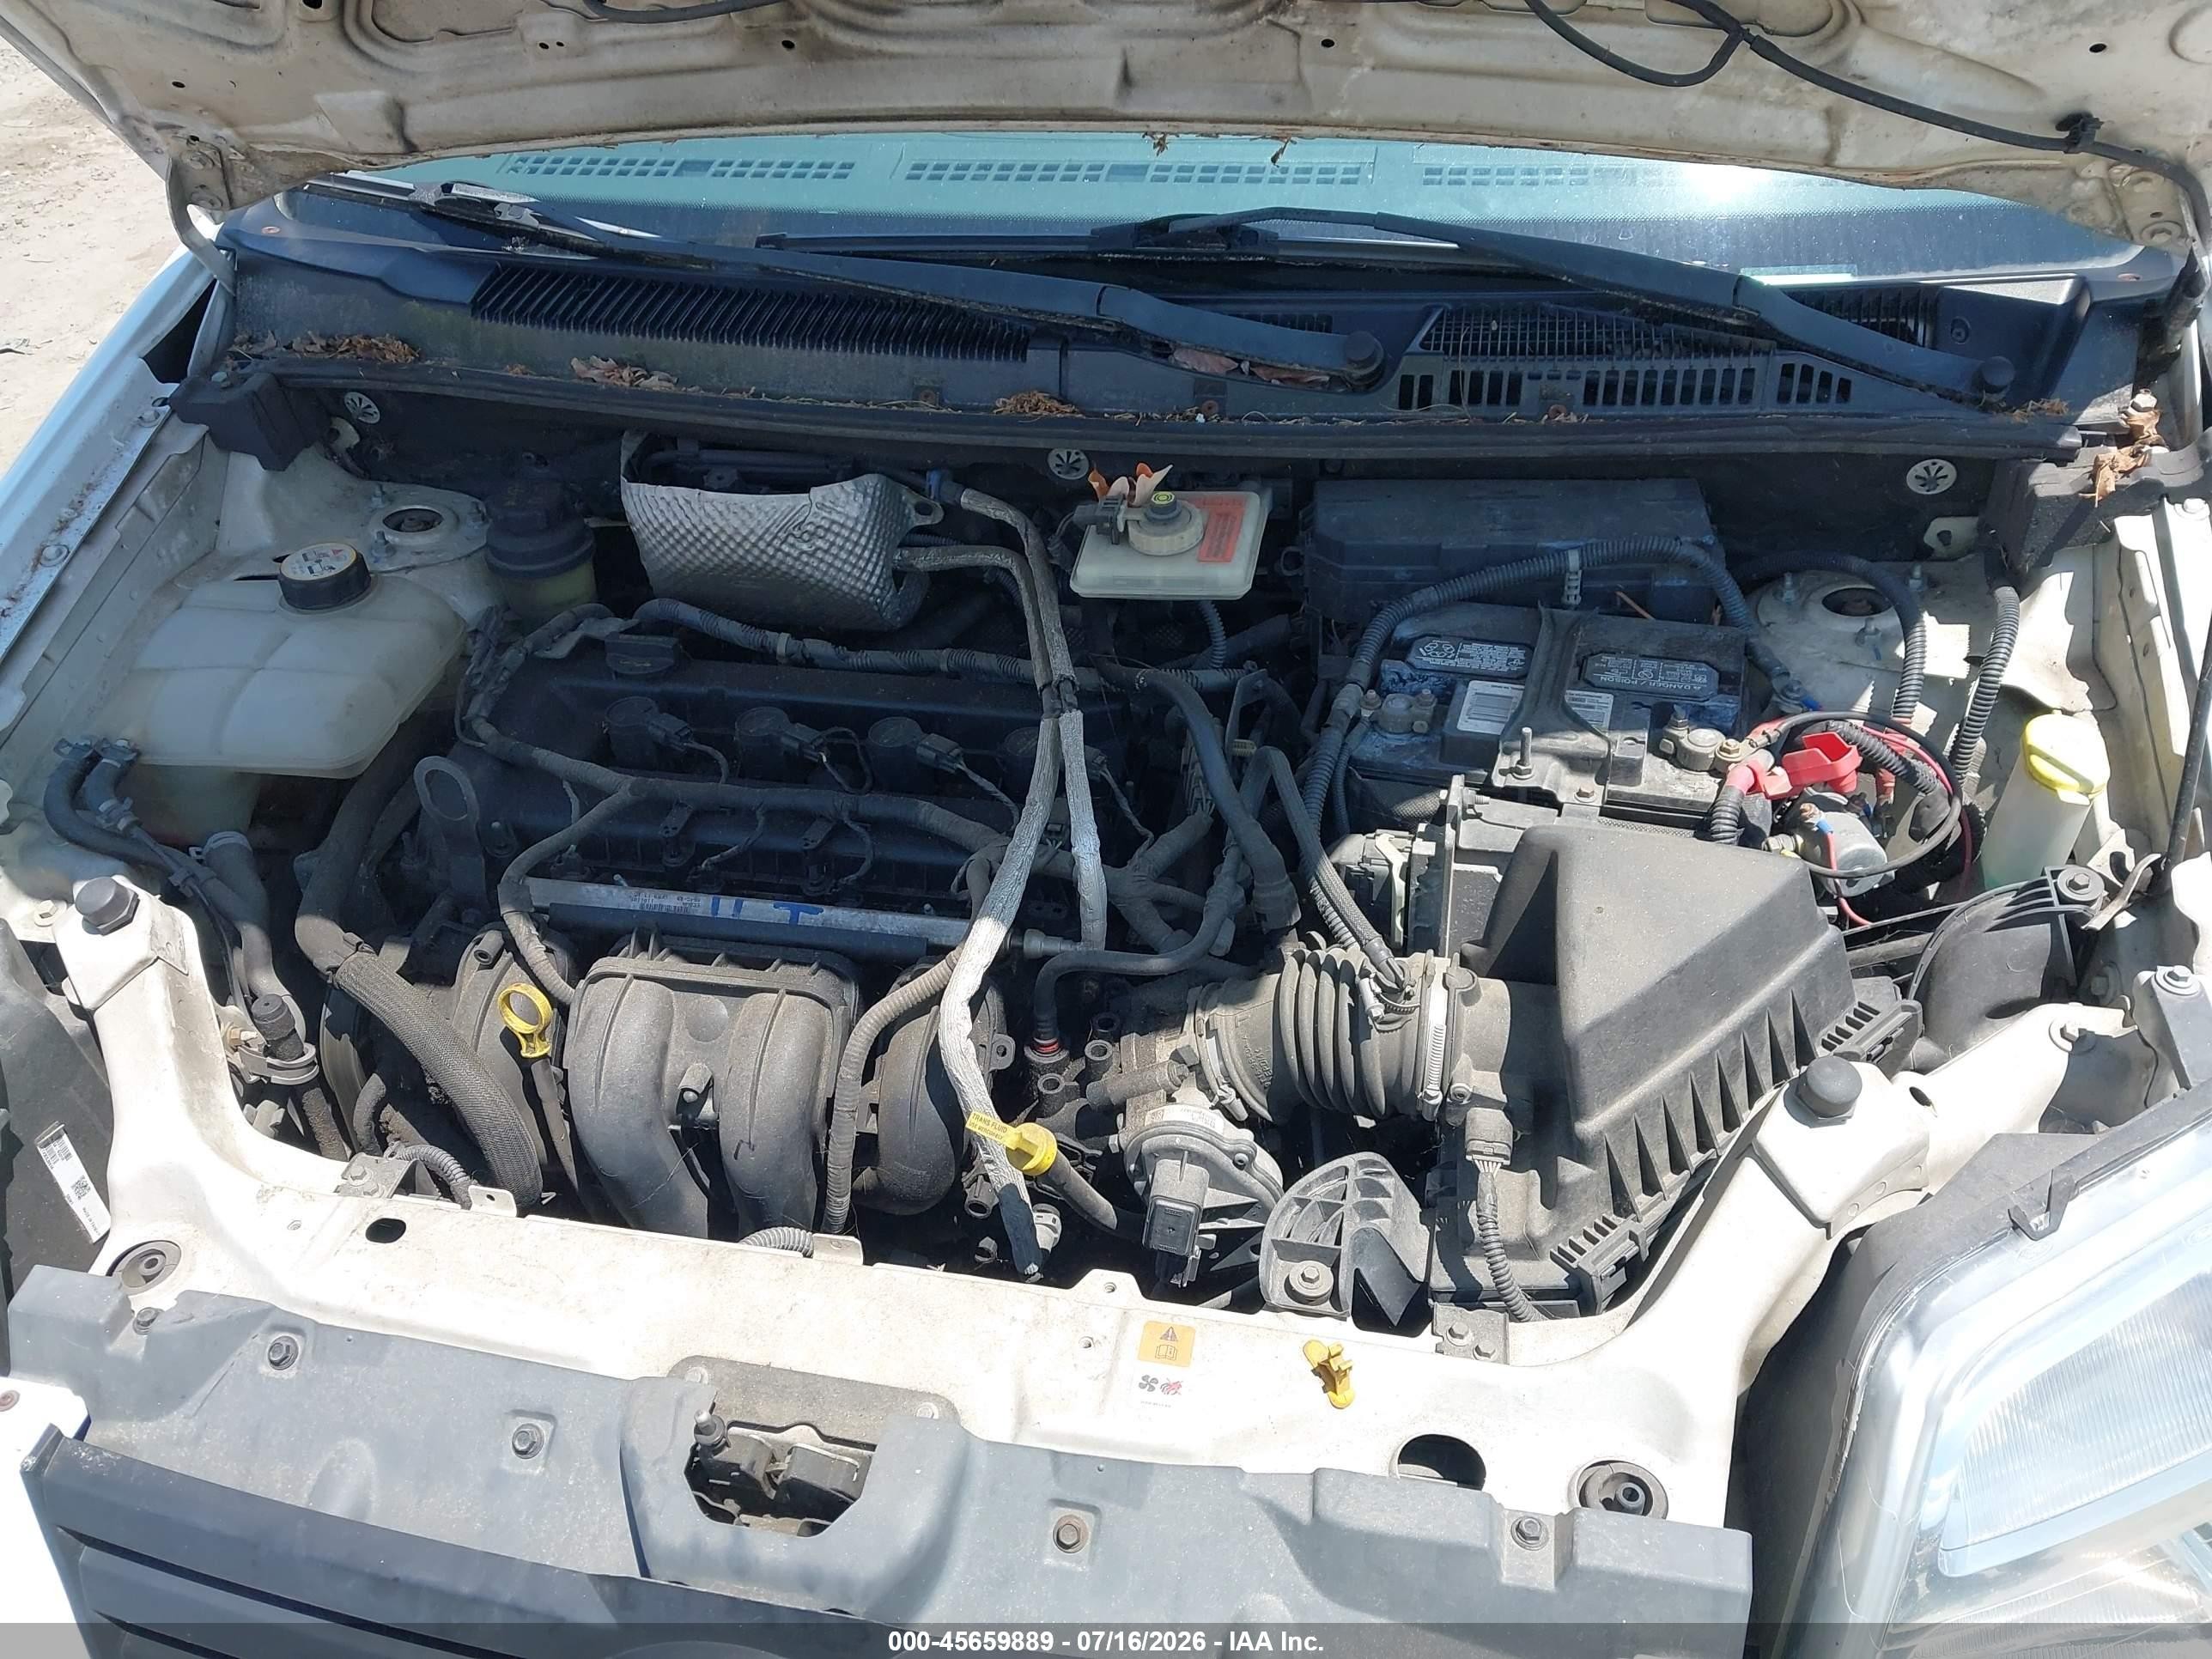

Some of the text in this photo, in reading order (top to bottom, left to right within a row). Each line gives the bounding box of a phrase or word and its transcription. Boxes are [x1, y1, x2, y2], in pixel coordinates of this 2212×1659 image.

[1600, 675, 1638, 685] POISON
[1649, 680, 1691, 690] DANGER
[971, 1112, 1008, 1133] TRANS FLUID
